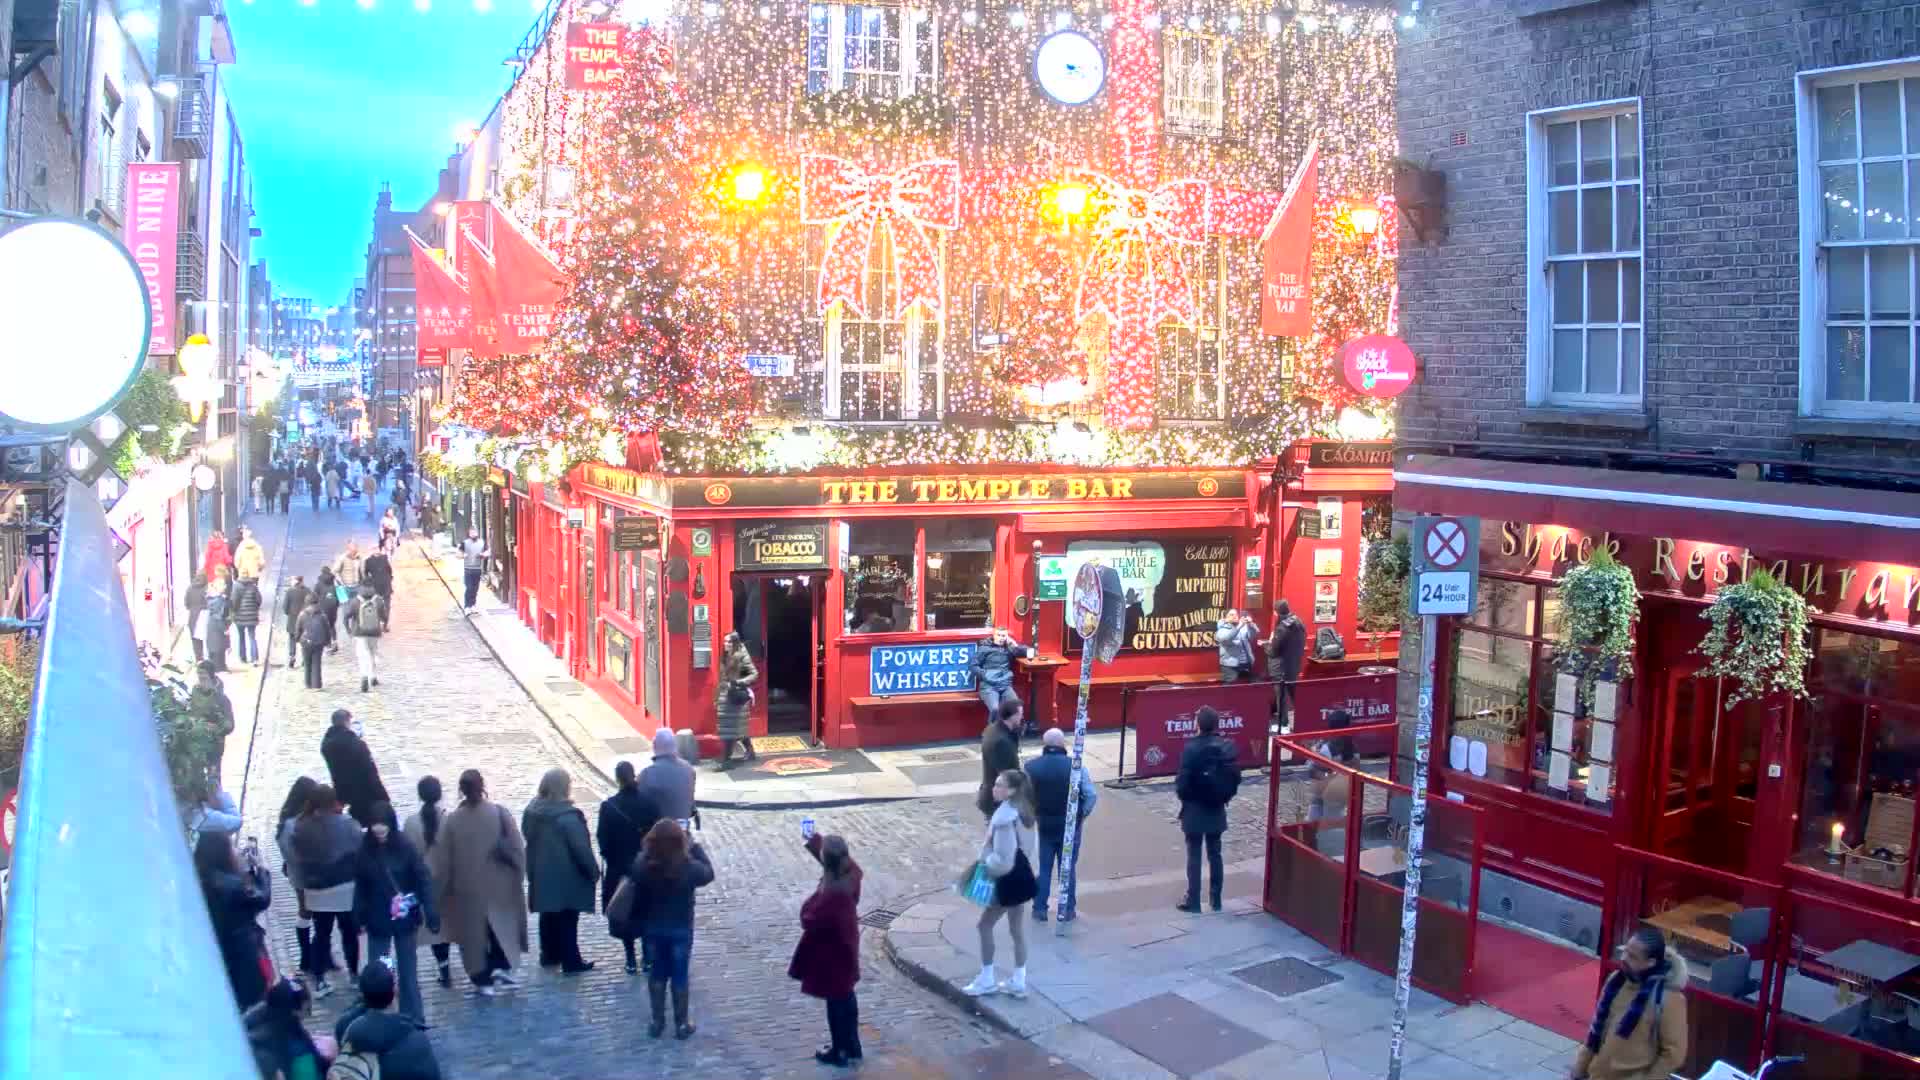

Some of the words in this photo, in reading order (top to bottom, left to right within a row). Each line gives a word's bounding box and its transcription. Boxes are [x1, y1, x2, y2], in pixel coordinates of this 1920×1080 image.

[585, 28, 618, 45] THE
[137, 170, 169, 232] NINE
[1279, 272, 1297, 284] THE
[519, 304, 545, 313] THE
[823, 481, 899, 504] THE
[912, 479, 1050, 503] TEMPLE
[1066, 477, 1133, 499] BAR
[748, 538, 817, 562] TOBACCO
[1501, 520, 1621, 566] Shack
[1123, 547, 1147, 557] THE
[1110, 556, 1157, 568] TEMPLE
[1203, 562, 1227, 577] THE
[1121, 567, 1147, 578] BAR
[1175, 577, 1227, 593] EMPEROR
[1421, 583, 1443, 602] 24
[1211, 592, 1225, 607] OF
[1444, 594, 1466, 602] HOUR
[1138, 616, 1182, 632] MALTED
[1132, 631, 1218, 650] GUINNES
[880, 647, 969, 668] POWER'S
[873, 670, 972, 690] WHISKEY
[1367, 703, 1390, 716] BAR
[1218, 716, 1244, 729] BAR
